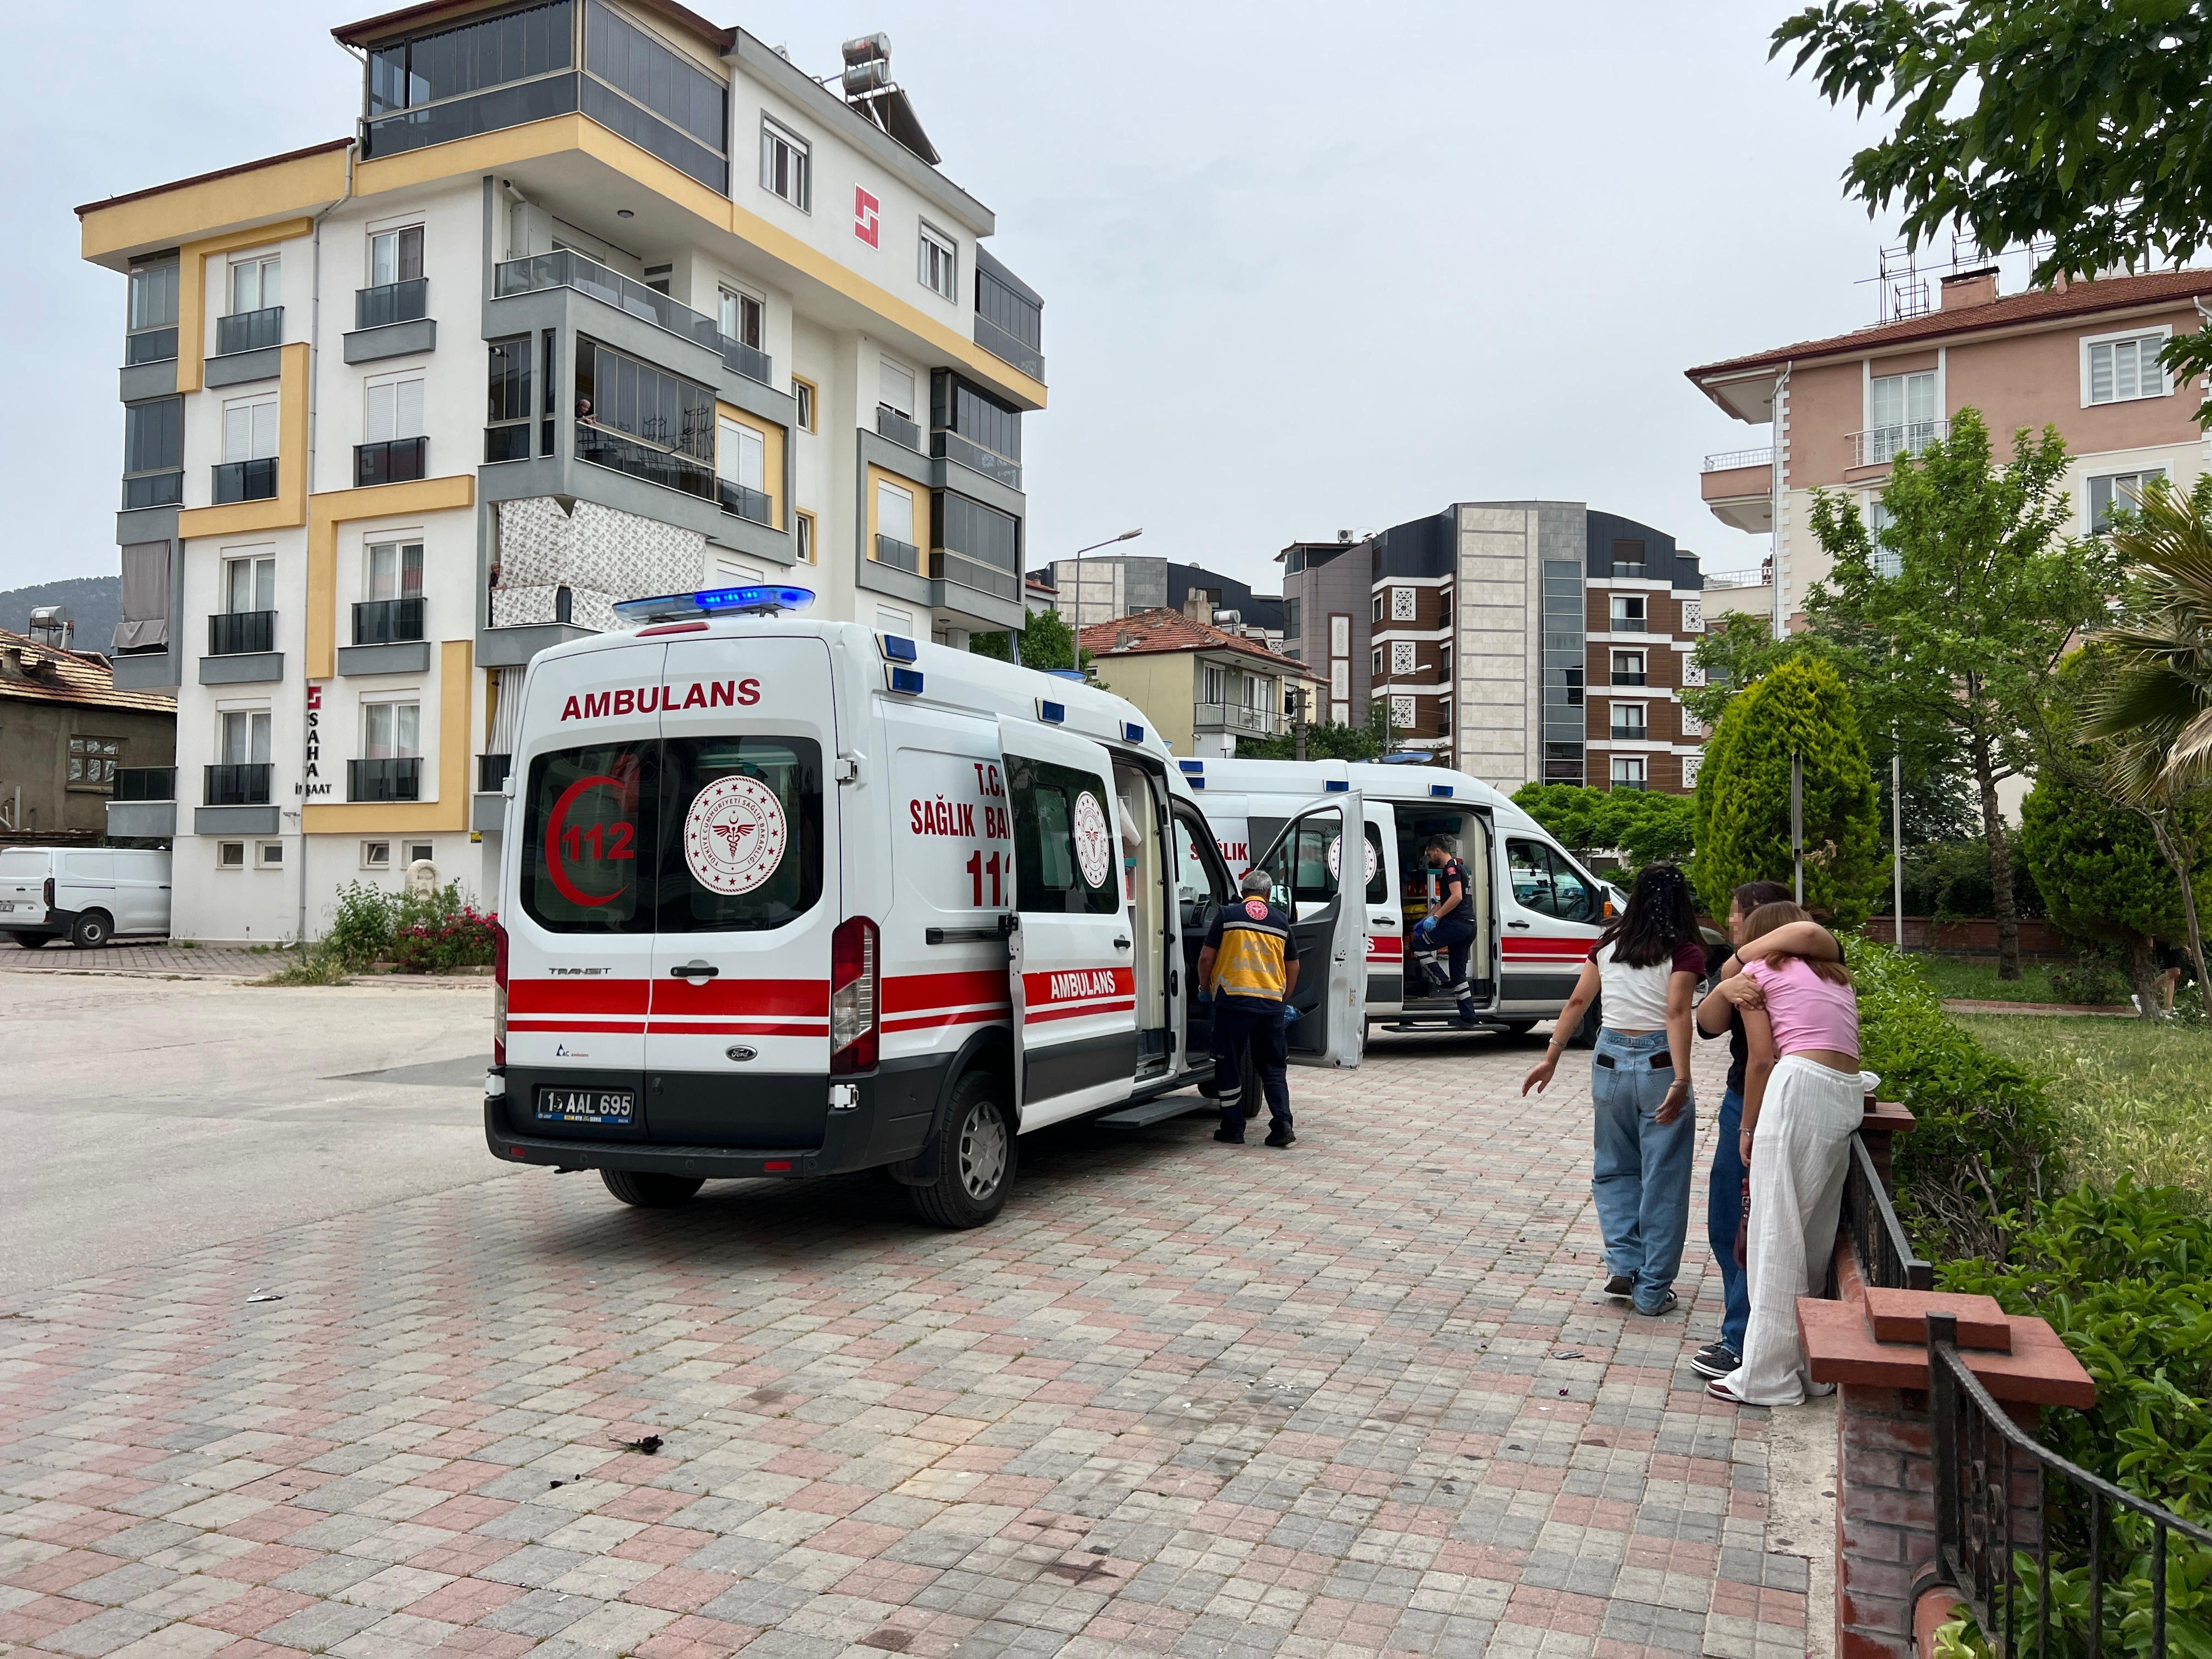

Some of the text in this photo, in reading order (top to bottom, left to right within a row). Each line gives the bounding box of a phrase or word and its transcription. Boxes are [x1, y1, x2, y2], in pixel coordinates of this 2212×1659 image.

[560, 678, 760, 721] AMBULANS
[307, 712, 320, 777] SAHA
[742, 799, 763, 821] SAĞLIK
[910, 794, 976, 837] SAĞLIK
[562, 822, 634, 861] 112
[1051, 970, 1115, 999] AMBULANS
[566, 1093, 595, 1114] AAL
[600, 1095, 631, 1115] 695
